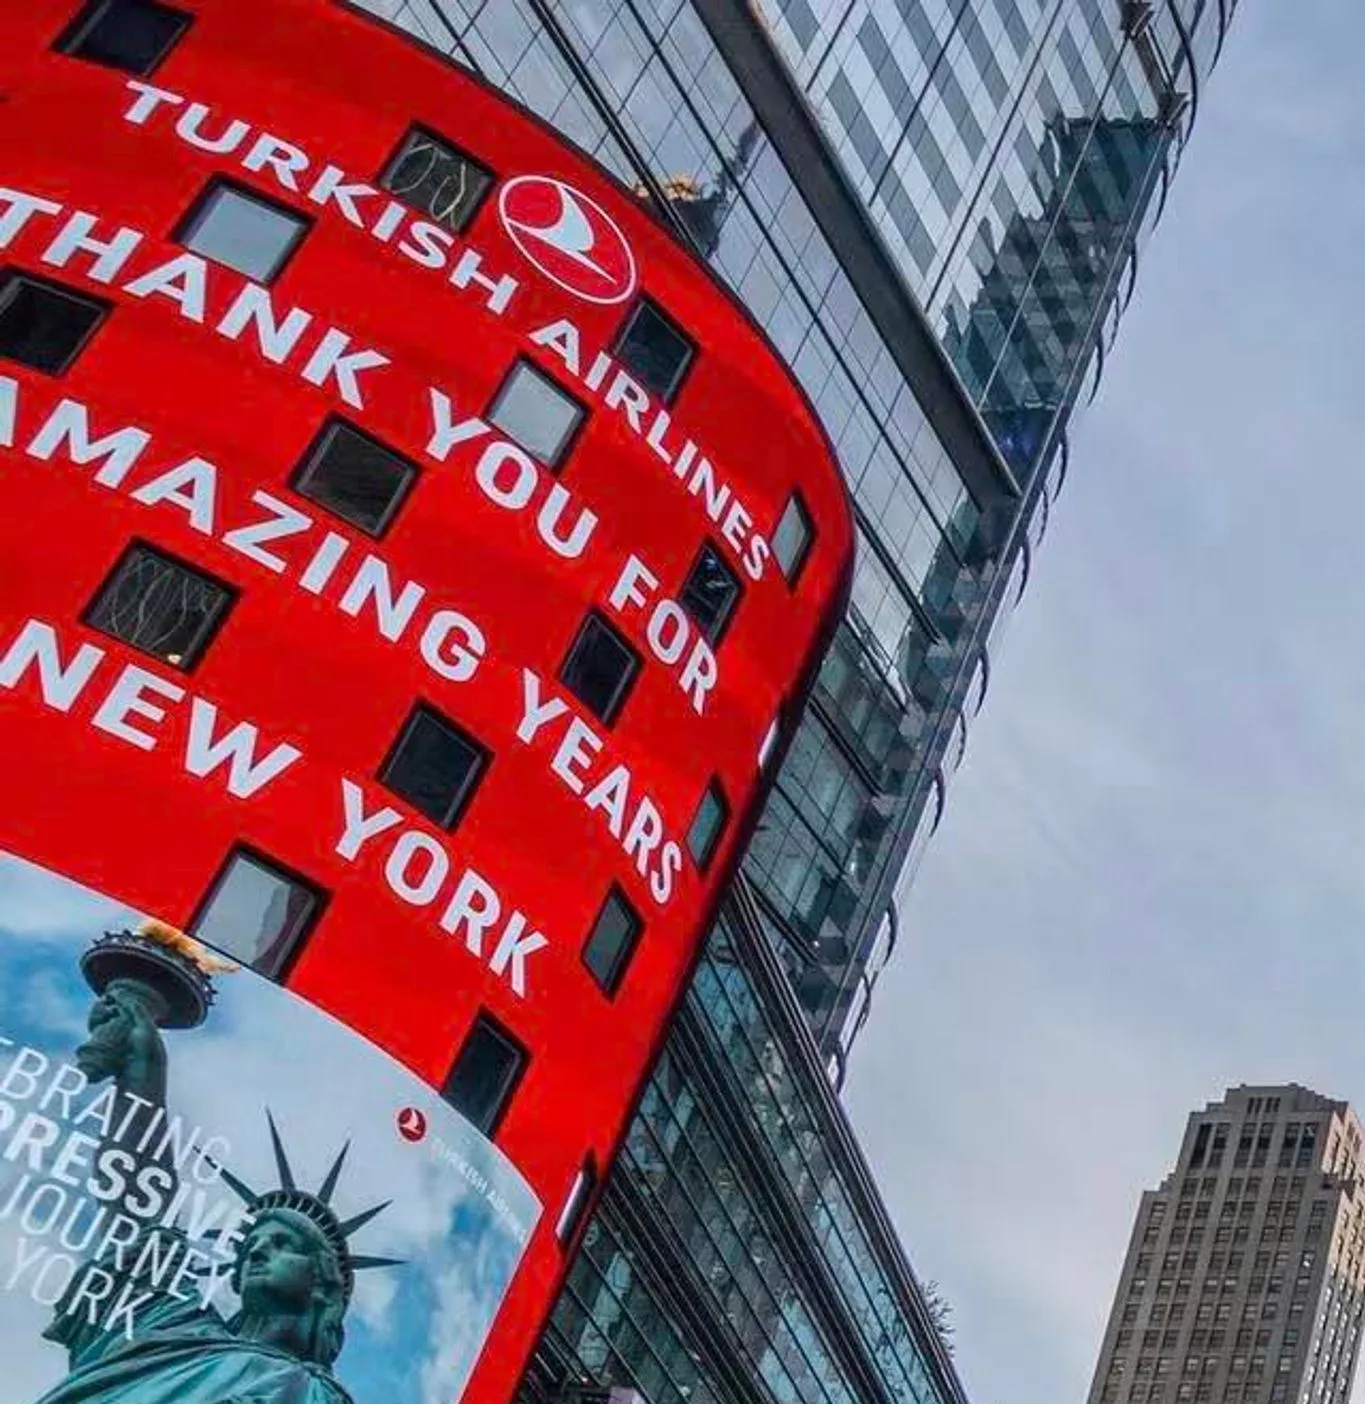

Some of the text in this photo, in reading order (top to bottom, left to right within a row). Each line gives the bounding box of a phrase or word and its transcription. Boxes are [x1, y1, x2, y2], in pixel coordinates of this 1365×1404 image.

[0, 188, 719, 716] THANK YOU FOR
[125, 81, 773, 581] TURKISH AIRLINES
[0, 376, 682, 904] MAZING YEARS
[0, 618, 549, 998] NEW YORK
[0, 1037, 232, 1186] BRATING
[0, 1174, 238, 1312] JOURNEY
[6, 1237, 155, 1340] YORK
